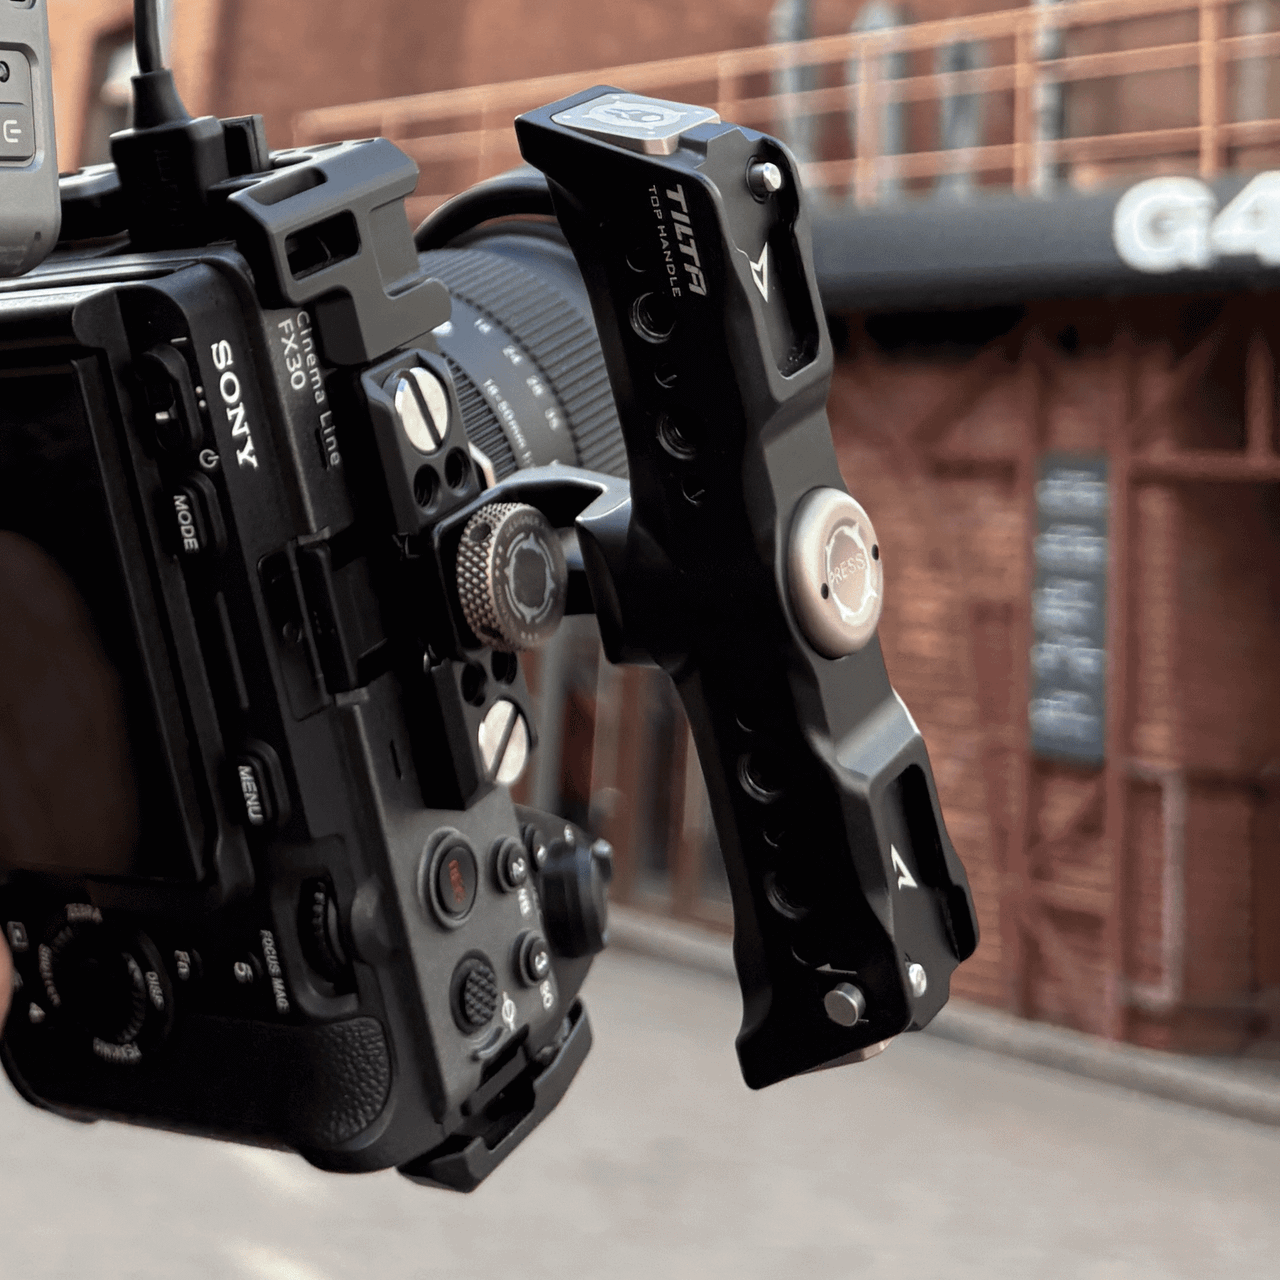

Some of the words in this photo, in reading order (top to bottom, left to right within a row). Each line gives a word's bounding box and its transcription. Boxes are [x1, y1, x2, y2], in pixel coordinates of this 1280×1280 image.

[648, 184, 662, 220] TOP
[656, 224, 682, 297] HANDLE
[666, 183, 707, 296] TILTA
[278, 318, 306, 390] FX30
[297, 311, 325, 404] Cinema
[319, 410, 341, 467] Line
[210, 339, 258, 469] SONY
[173, 494, 199, 553] MODE
[830, 553, 866, 584] PRESS
[238, 764, 264, 824] MENU
[174, 950, 190, 979] Fn
[233, 961, 253, 984] 5
[260, 930, 279, 978] FOCUS
[272, 978, 289, 1012] MAG
